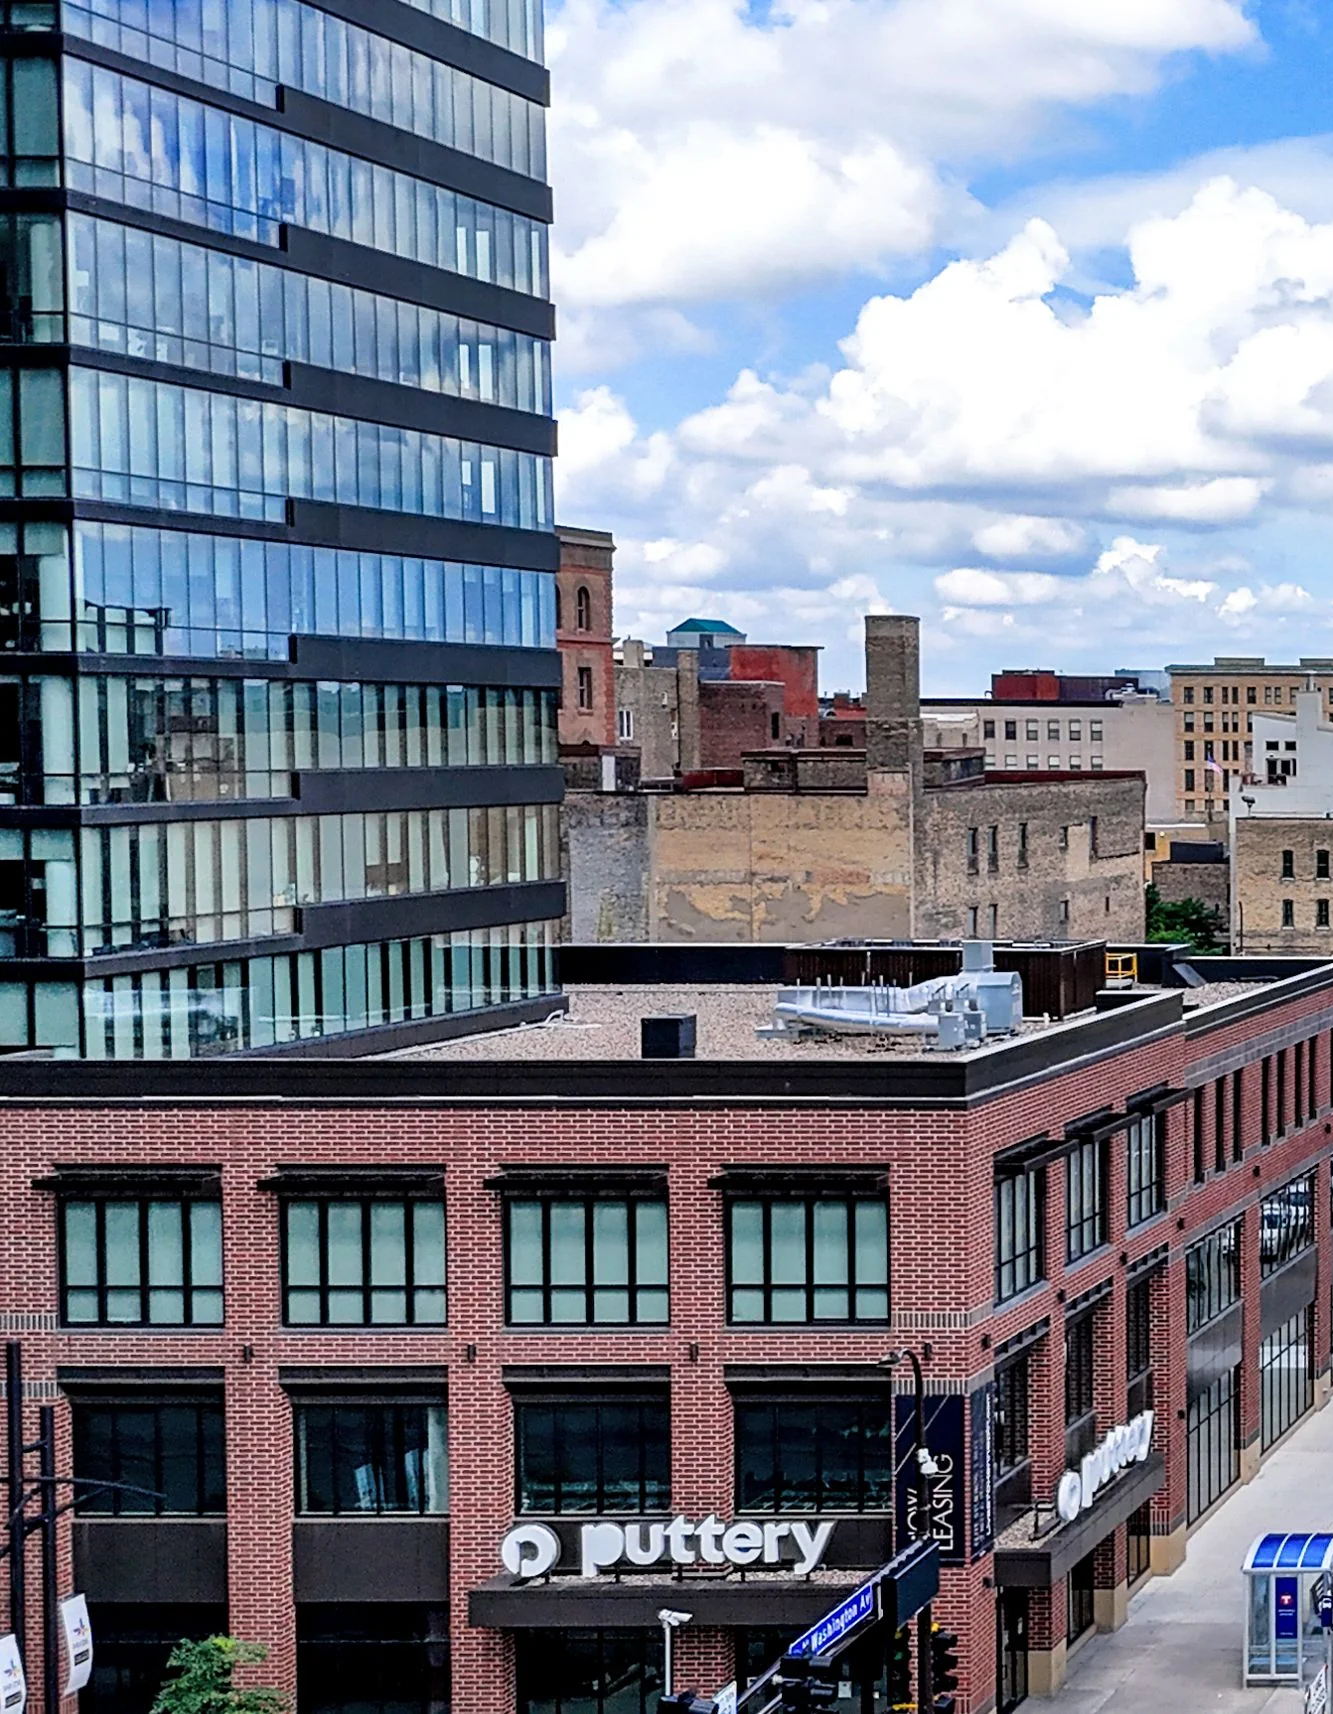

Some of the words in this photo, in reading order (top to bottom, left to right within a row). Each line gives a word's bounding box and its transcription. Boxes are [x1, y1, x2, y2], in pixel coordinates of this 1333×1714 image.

[932, 1453, 954, 1551] LEASING
[581, 1514, 836, 1577] puttery
[810, 1602, 859, 1652] Washington
